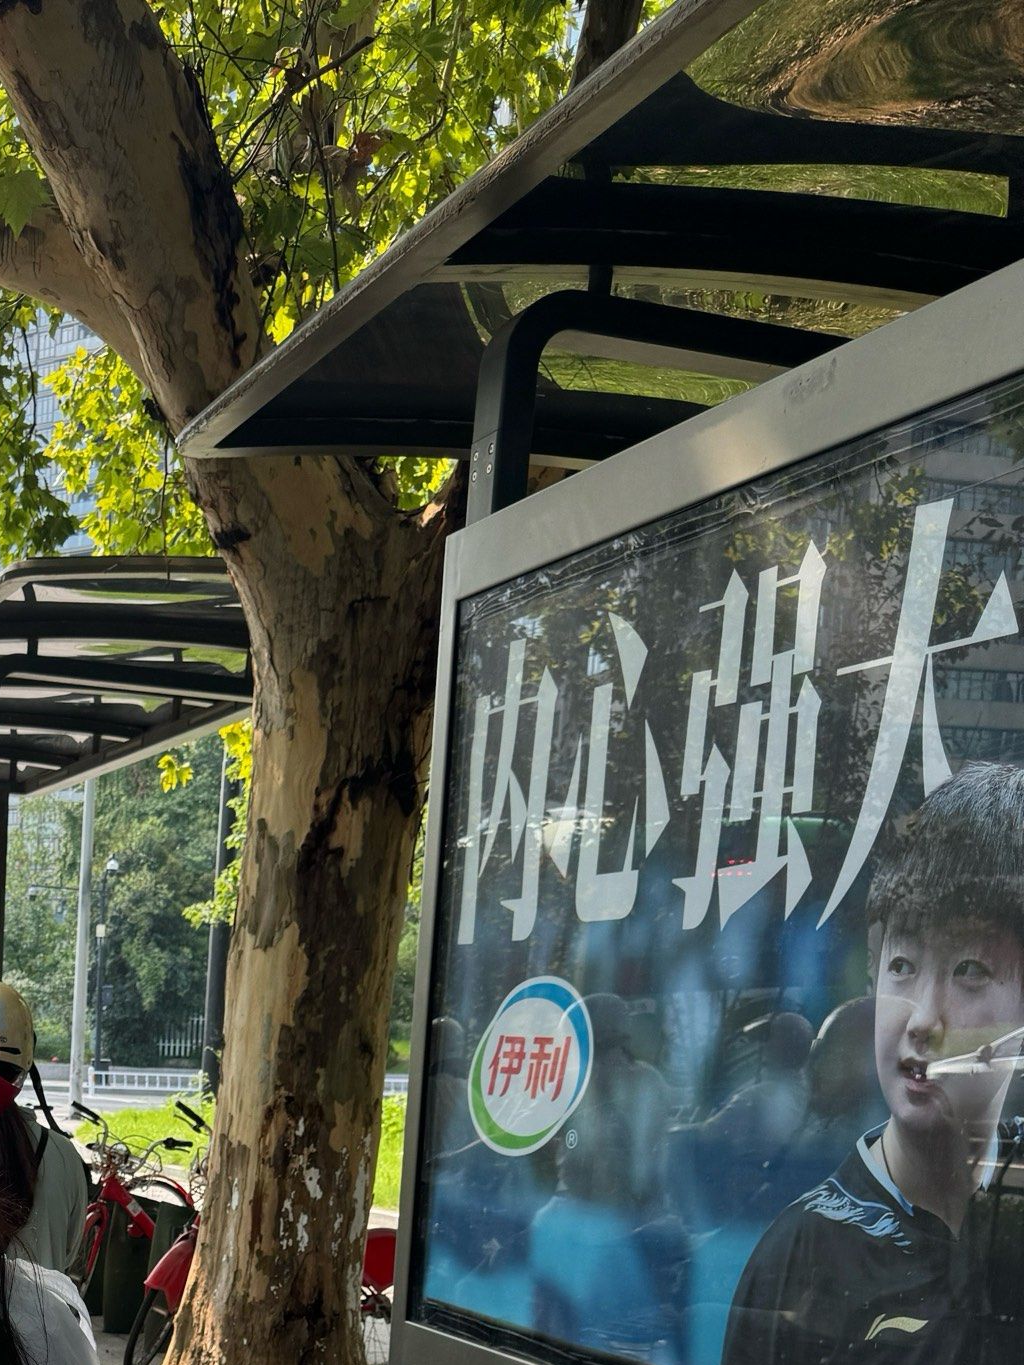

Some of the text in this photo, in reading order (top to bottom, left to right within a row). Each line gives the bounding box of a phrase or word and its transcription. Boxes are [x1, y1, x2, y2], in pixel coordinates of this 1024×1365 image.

[458, 498, 1019, 945] 内心强大
[487, 1034, 572, 1102] 伊利
